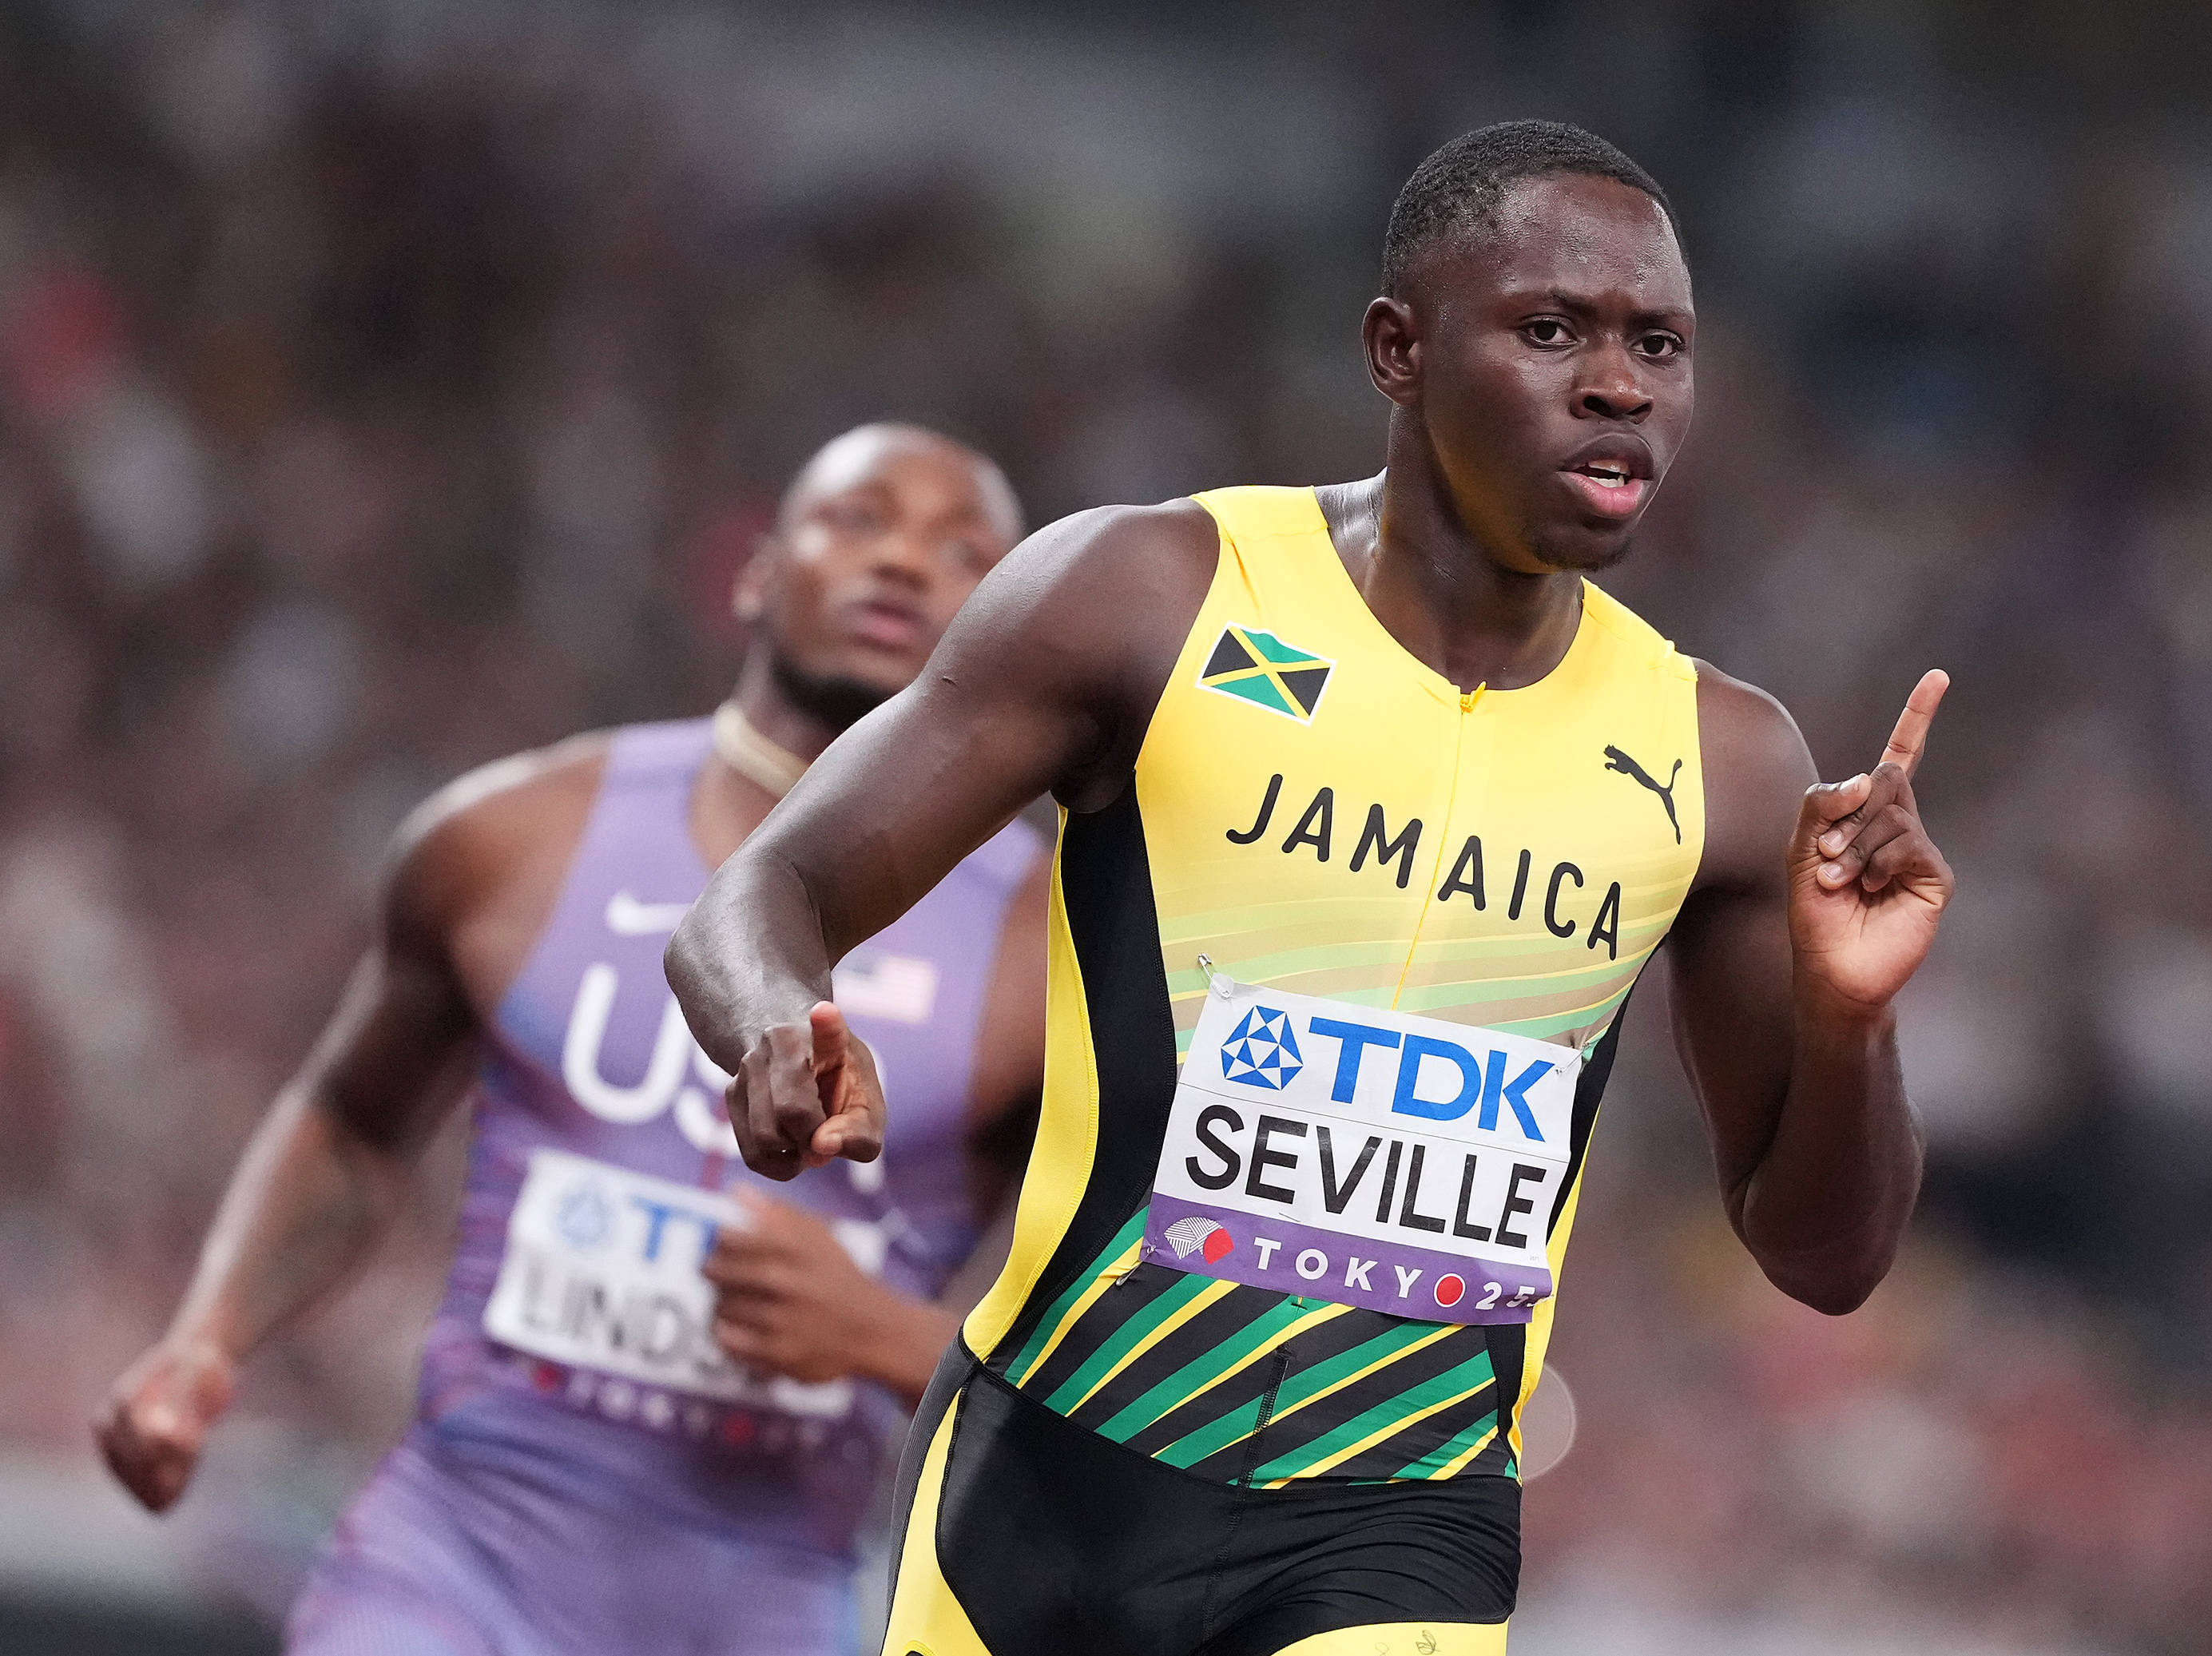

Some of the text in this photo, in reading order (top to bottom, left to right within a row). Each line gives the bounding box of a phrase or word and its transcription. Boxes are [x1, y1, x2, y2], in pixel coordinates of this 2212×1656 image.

[1225, 773, 1621, 961] JAMAICA
[1309, 1016, 1555, 1142] TDK
[1185, 1104, 1547, 1249] SEVILLE
